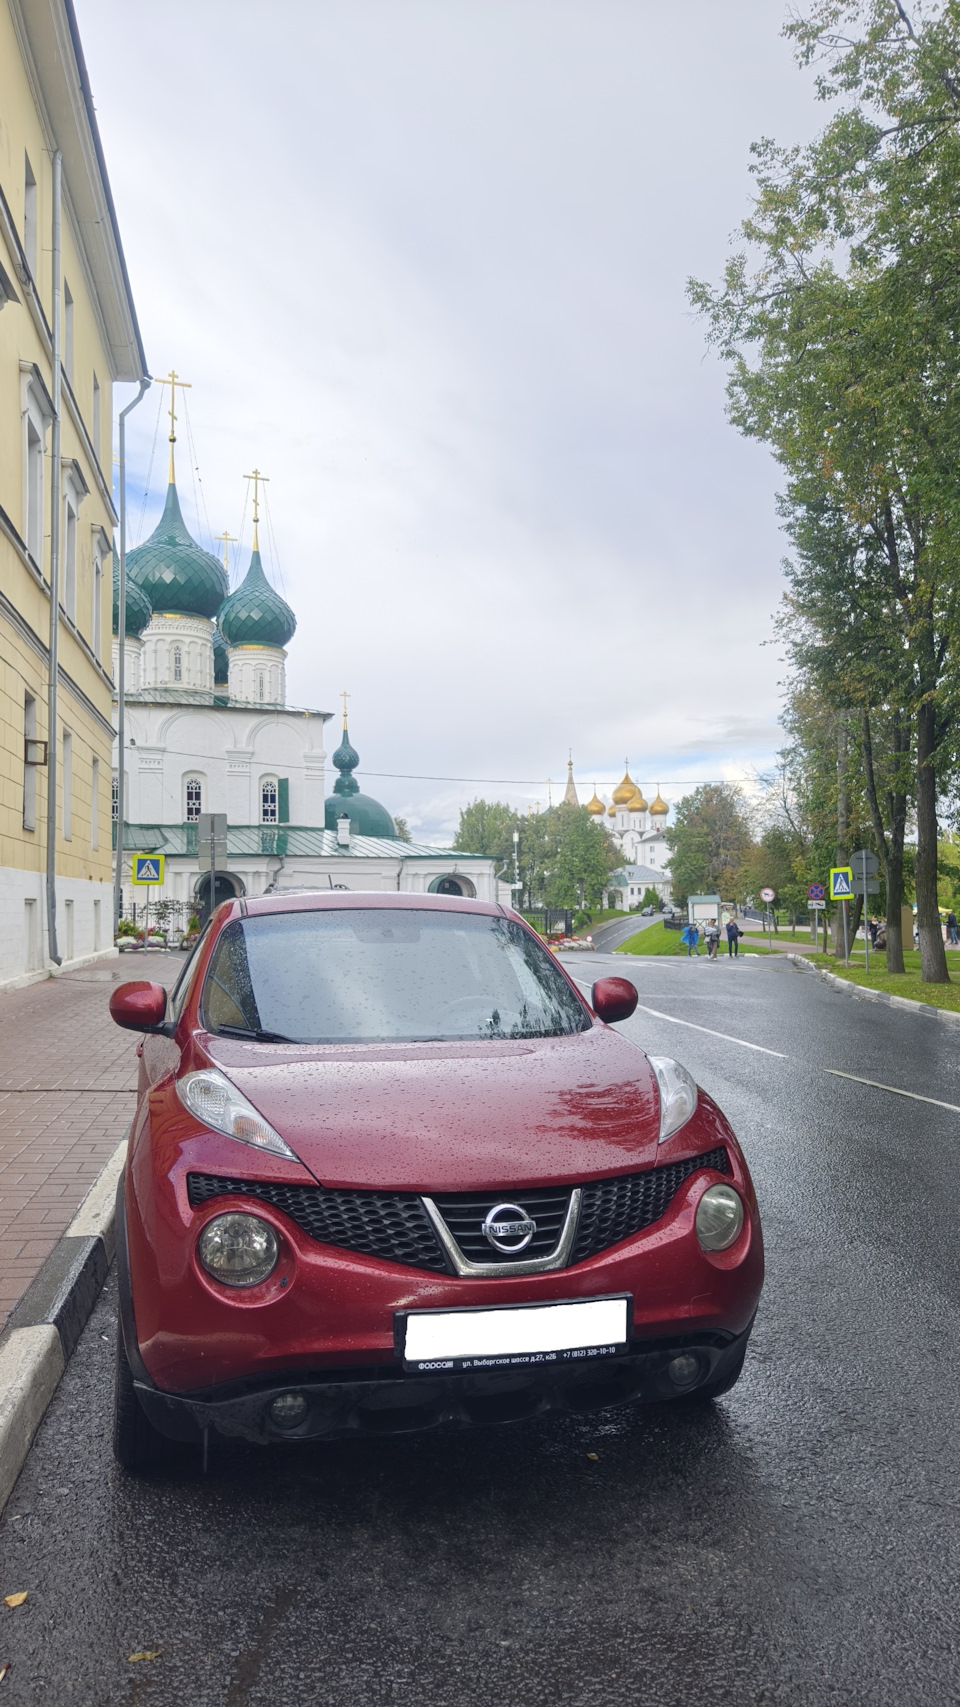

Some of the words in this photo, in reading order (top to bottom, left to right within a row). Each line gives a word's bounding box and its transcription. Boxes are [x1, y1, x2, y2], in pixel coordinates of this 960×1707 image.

[489, 1224, 532, 1233] NISSAN
[462, 1361, 472, 1369] ул.
[473, 1358, 510, 1366] Выборгское
[511, 1356, 529, 1364] шоссе
[530, 1354, 545, 1362] д.27,
[571, 1349, 586, 1358] (812)
[587, 1346, 616, 1356] 320-10-10
